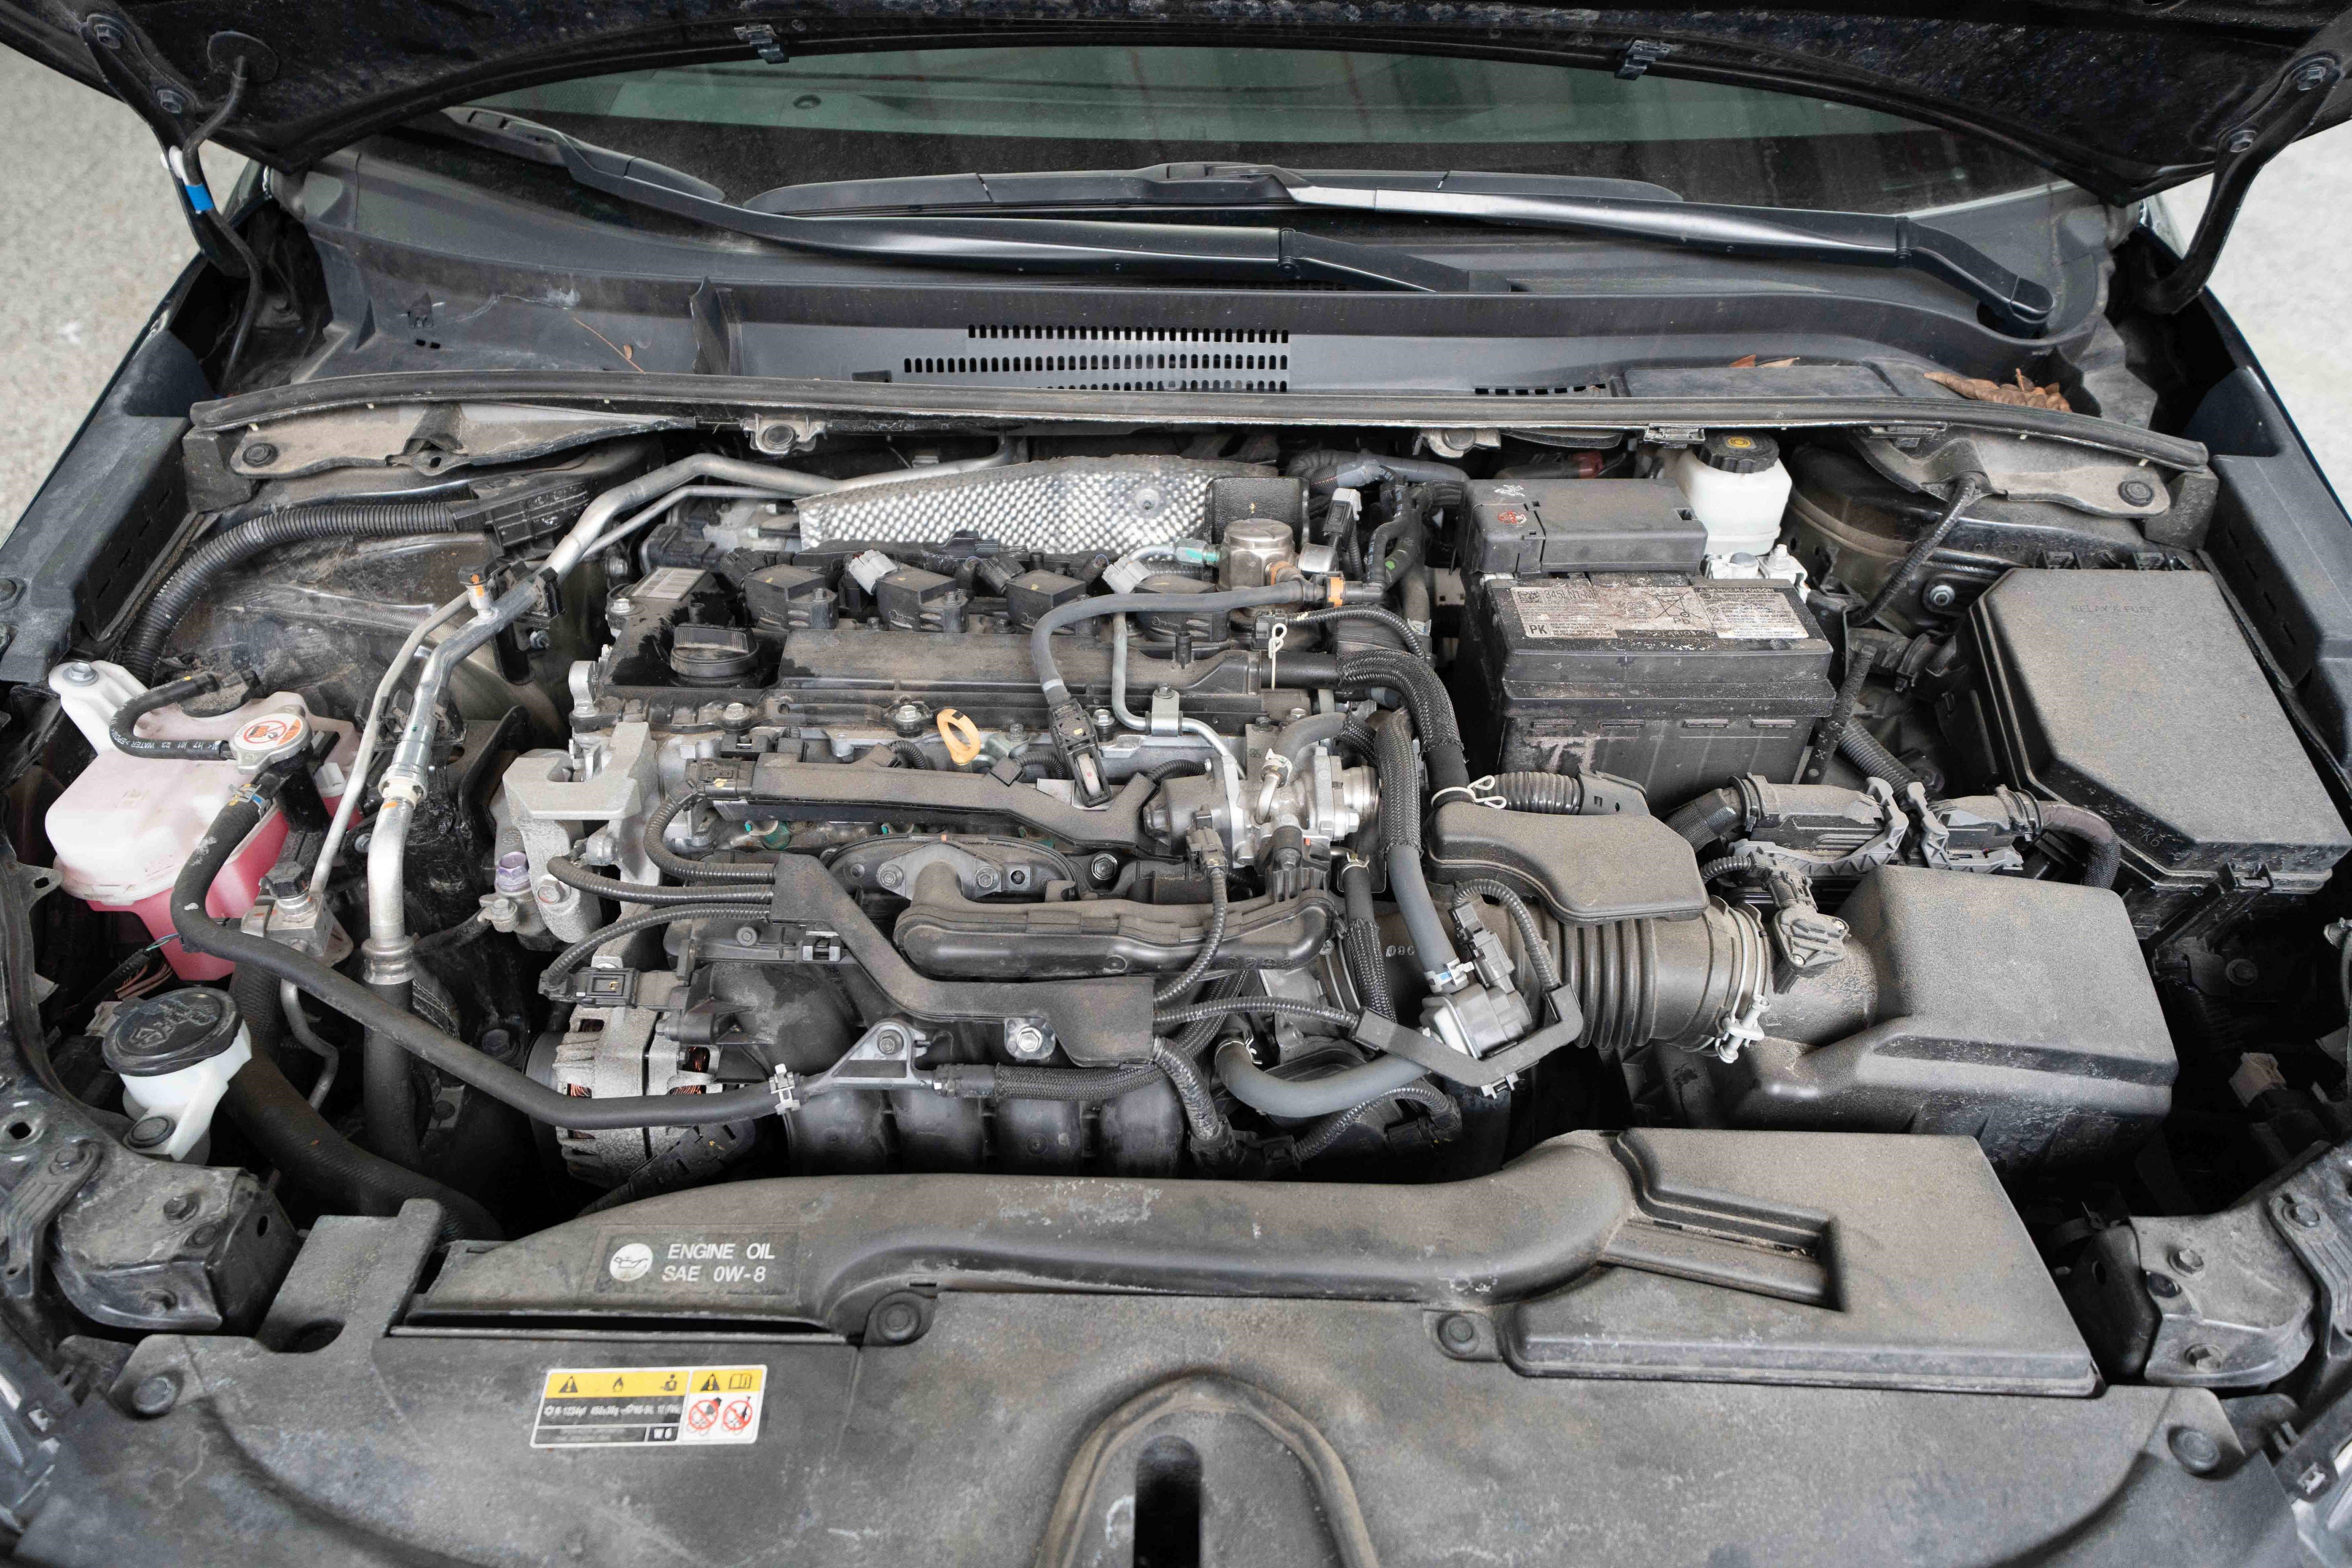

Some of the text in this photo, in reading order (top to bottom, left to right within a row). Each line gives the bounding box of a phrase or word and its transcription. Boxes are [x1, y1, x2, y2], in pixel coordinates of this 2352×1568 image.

[1529, 624, 1548, 634] PK
[667, 1243, 775, 1259] ENGINE OIL
[662, 1265, 766, 1282] SAE 0W-8
